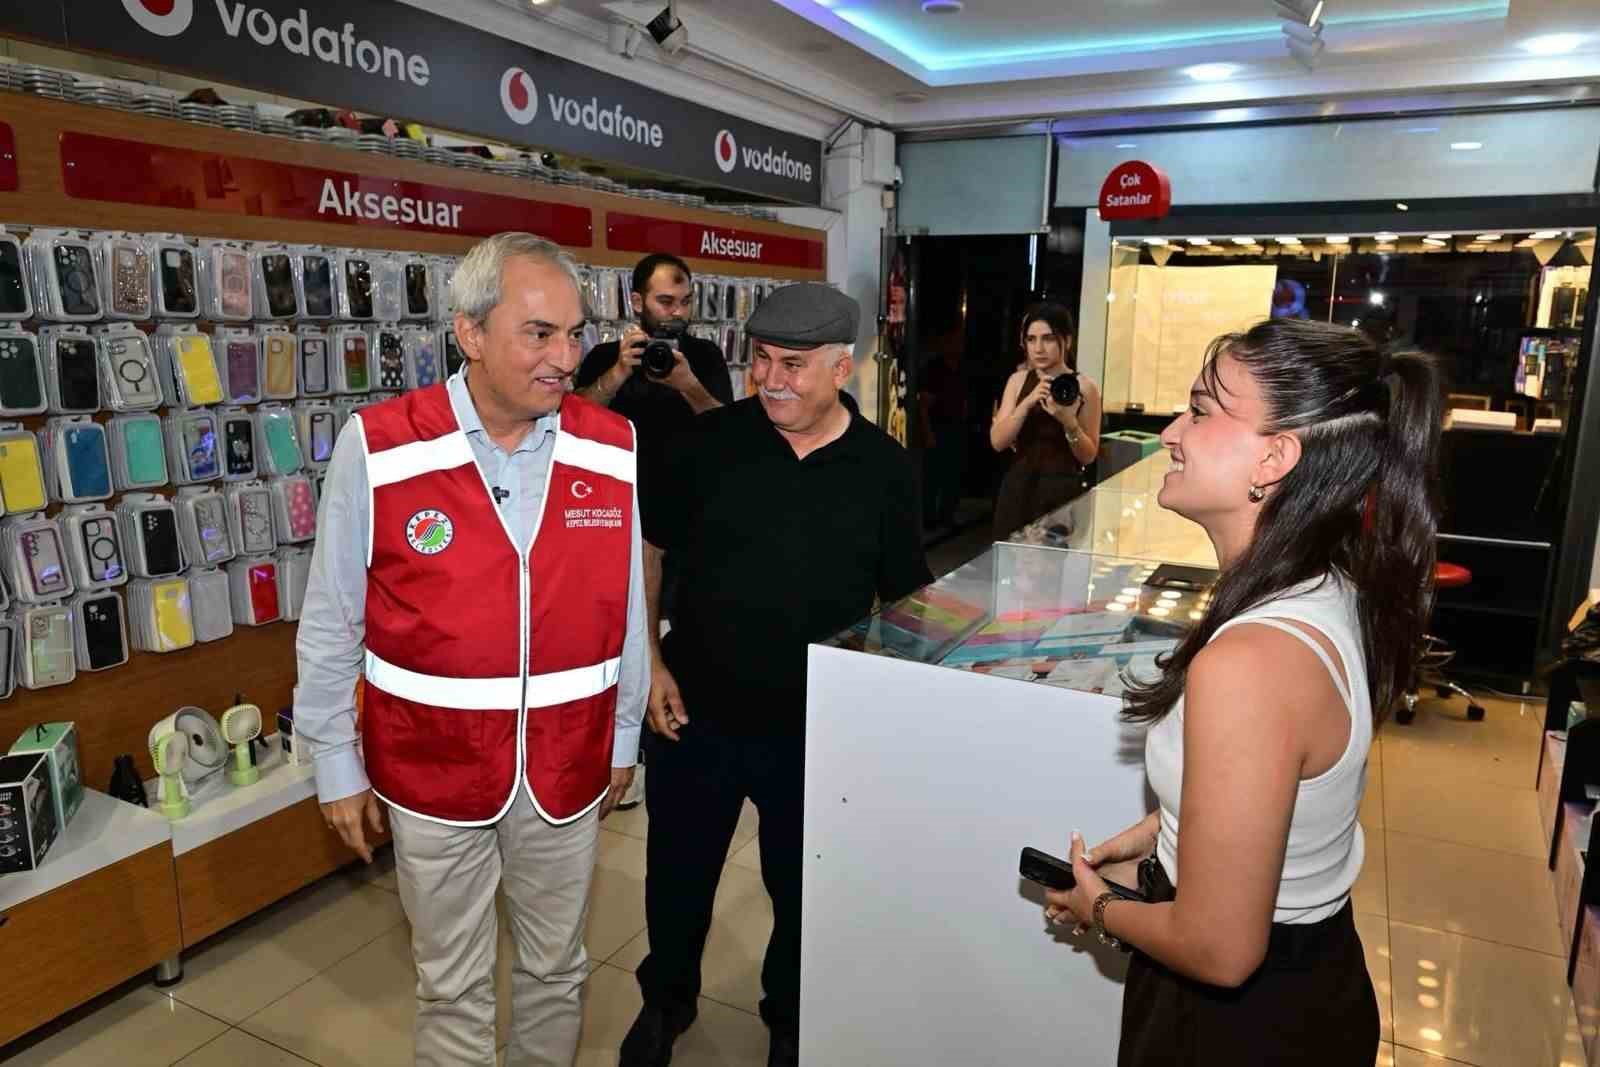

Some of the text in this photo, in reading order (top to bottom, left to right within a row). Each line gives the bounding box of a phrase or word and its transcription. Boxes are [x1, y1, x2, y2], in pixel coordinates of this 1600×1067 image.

[215, 0, 432, 87] vodafone
[548, 92, 664, 148] vodafone
[742, 146, 812, 183] vodafone
[1120, 173, 1141, 190] Çok
[318, 178, 463, 229] Aksesuar
[1106, 192, 1152, 207] Satanlar
[700, 230, 763, 260] Aksesuar
[408, 511, 449, 529] KEPEZ
[564, 508, 591, 519] MESUT
